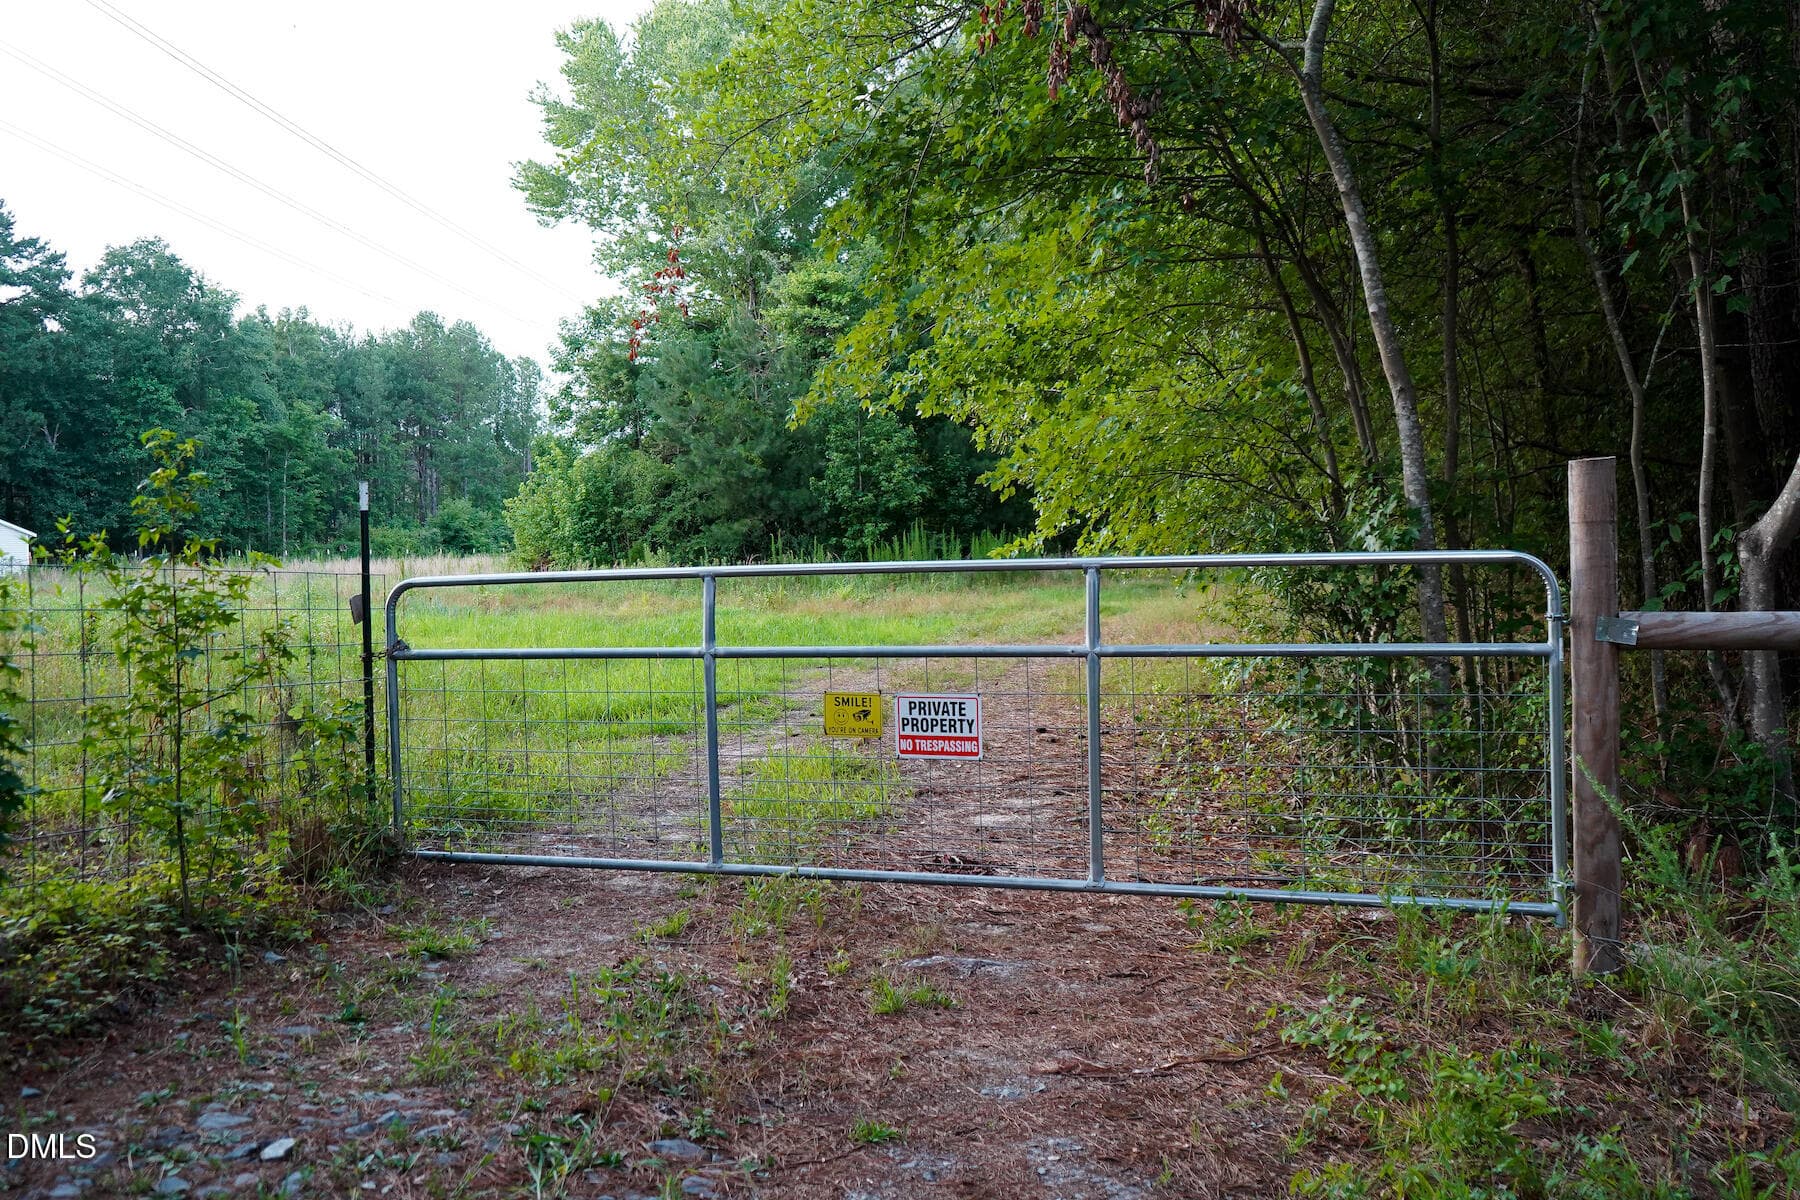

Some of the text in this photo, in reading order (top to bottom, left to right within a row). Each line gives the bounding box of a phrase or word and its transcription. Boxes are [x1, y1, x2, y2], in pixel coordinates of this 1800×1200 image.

[834, 696, 872, 708] SMILE!
[908, 701, 966, 717] PRIVATE
[858, 727, 879, 735] CAMERA
[901, 717, 975, 734] PROPERTY
[900, 739, 978, 753] NO TRESPASSING
